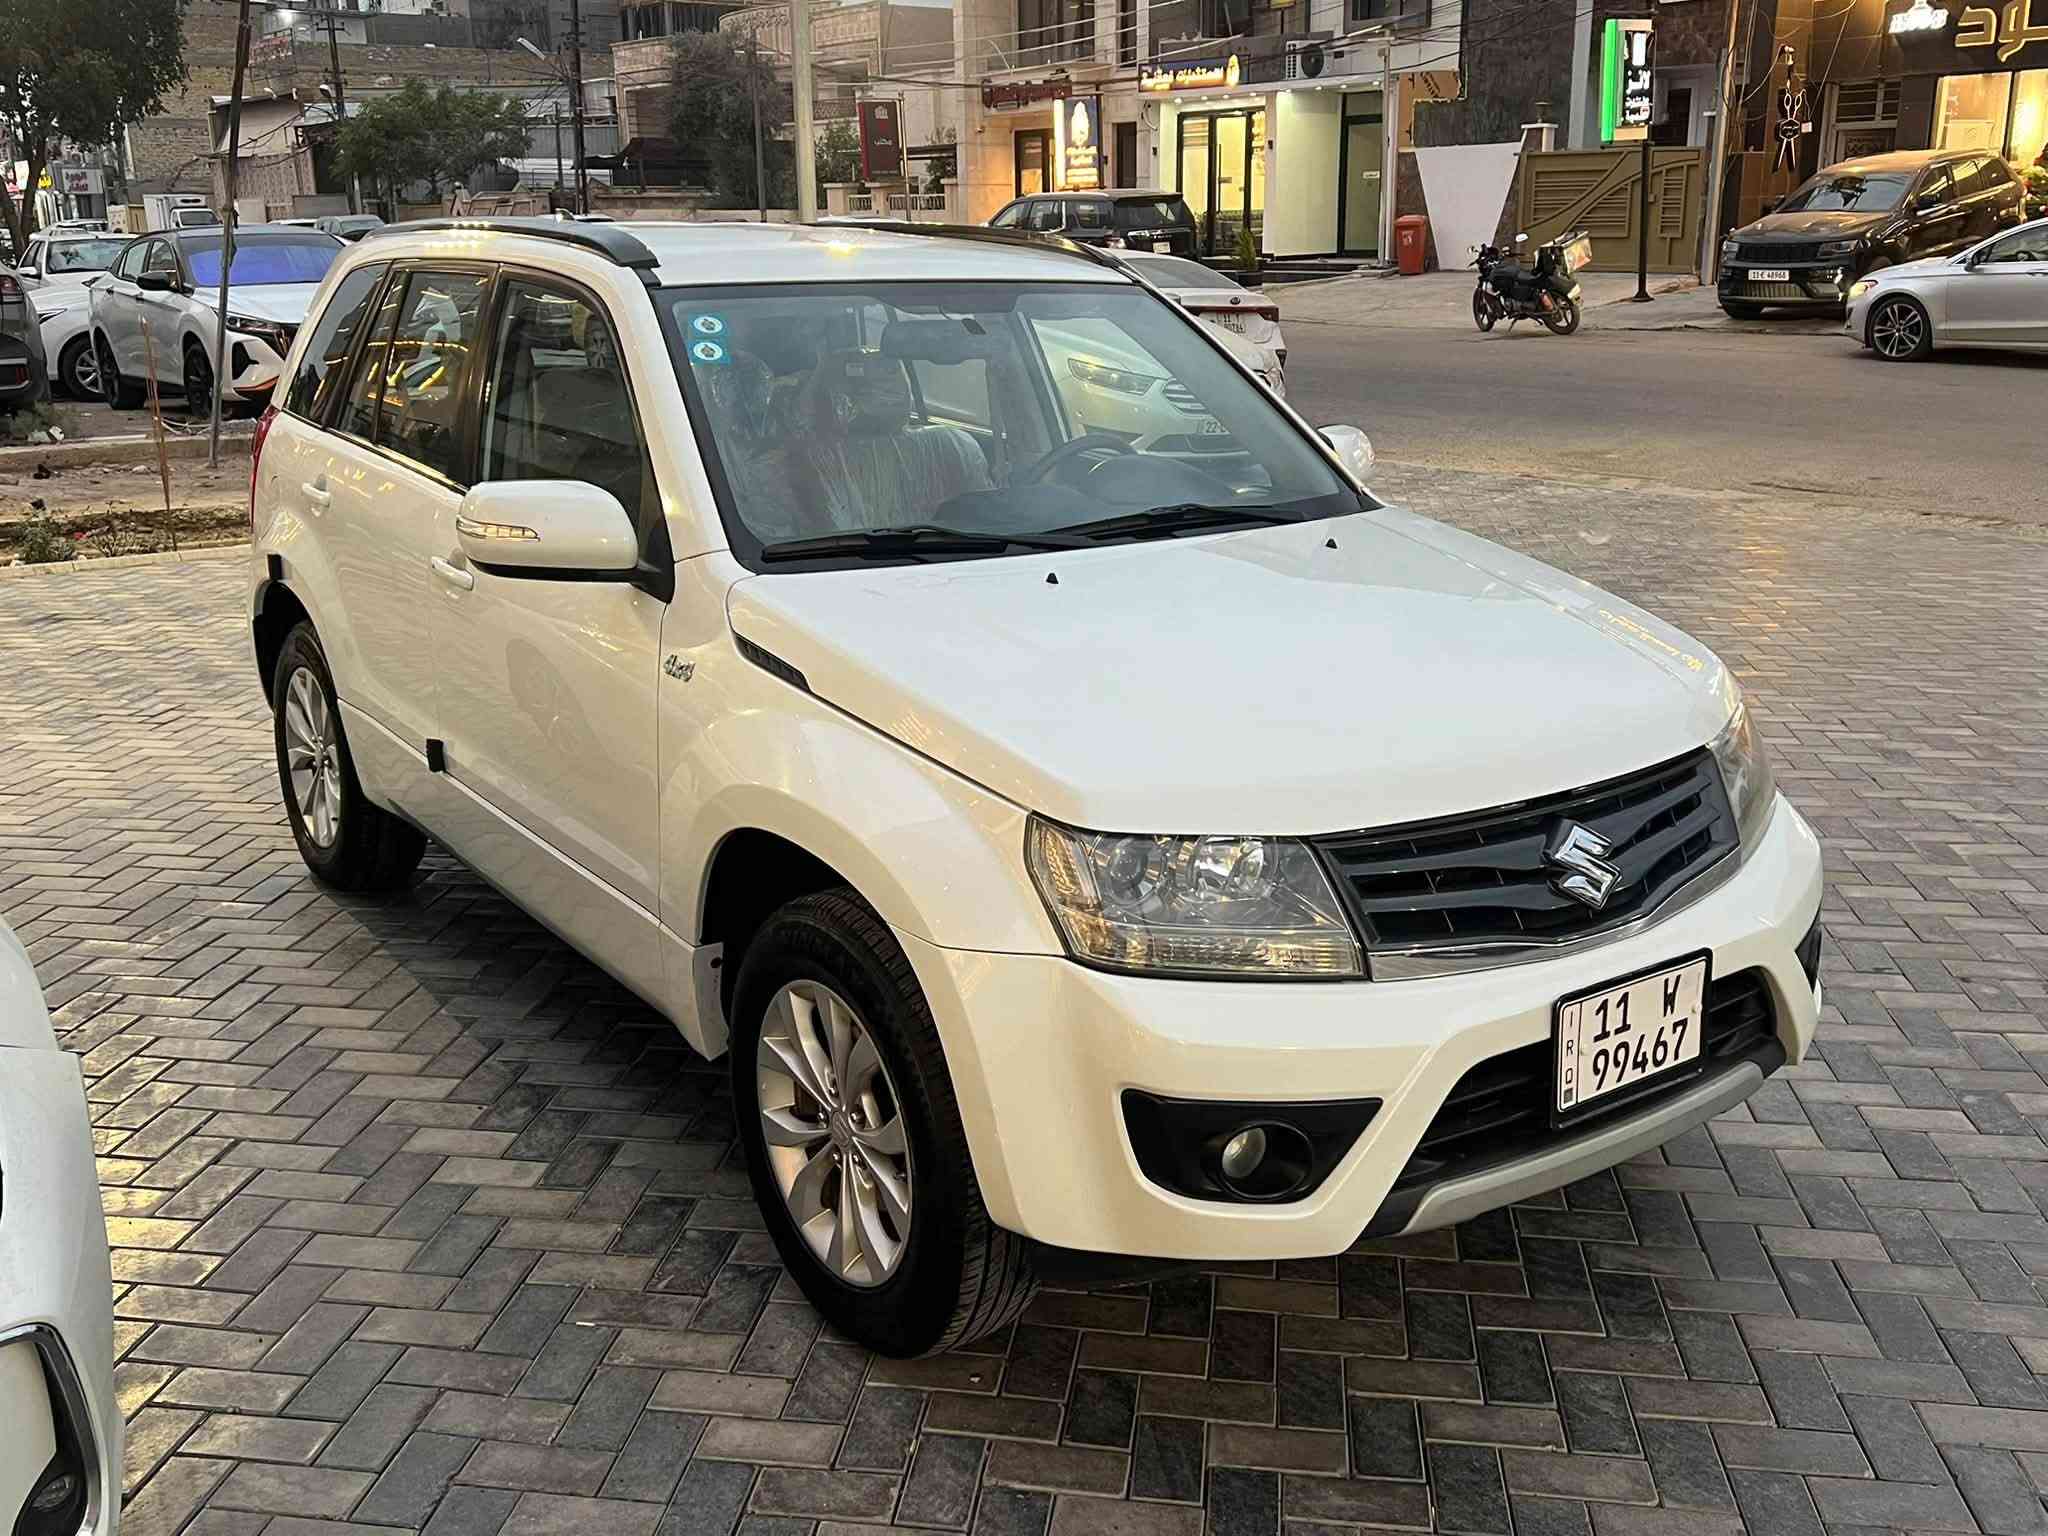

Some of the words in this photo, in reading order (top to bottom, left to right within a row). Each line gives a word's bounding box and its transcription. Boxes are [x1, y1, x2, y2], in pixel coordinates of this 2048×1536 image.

[1593, 991, 1631, 1043] 11
[1663, 973, 1682, 1018] W
[1592, 1017, 1689, 1091] 99467
